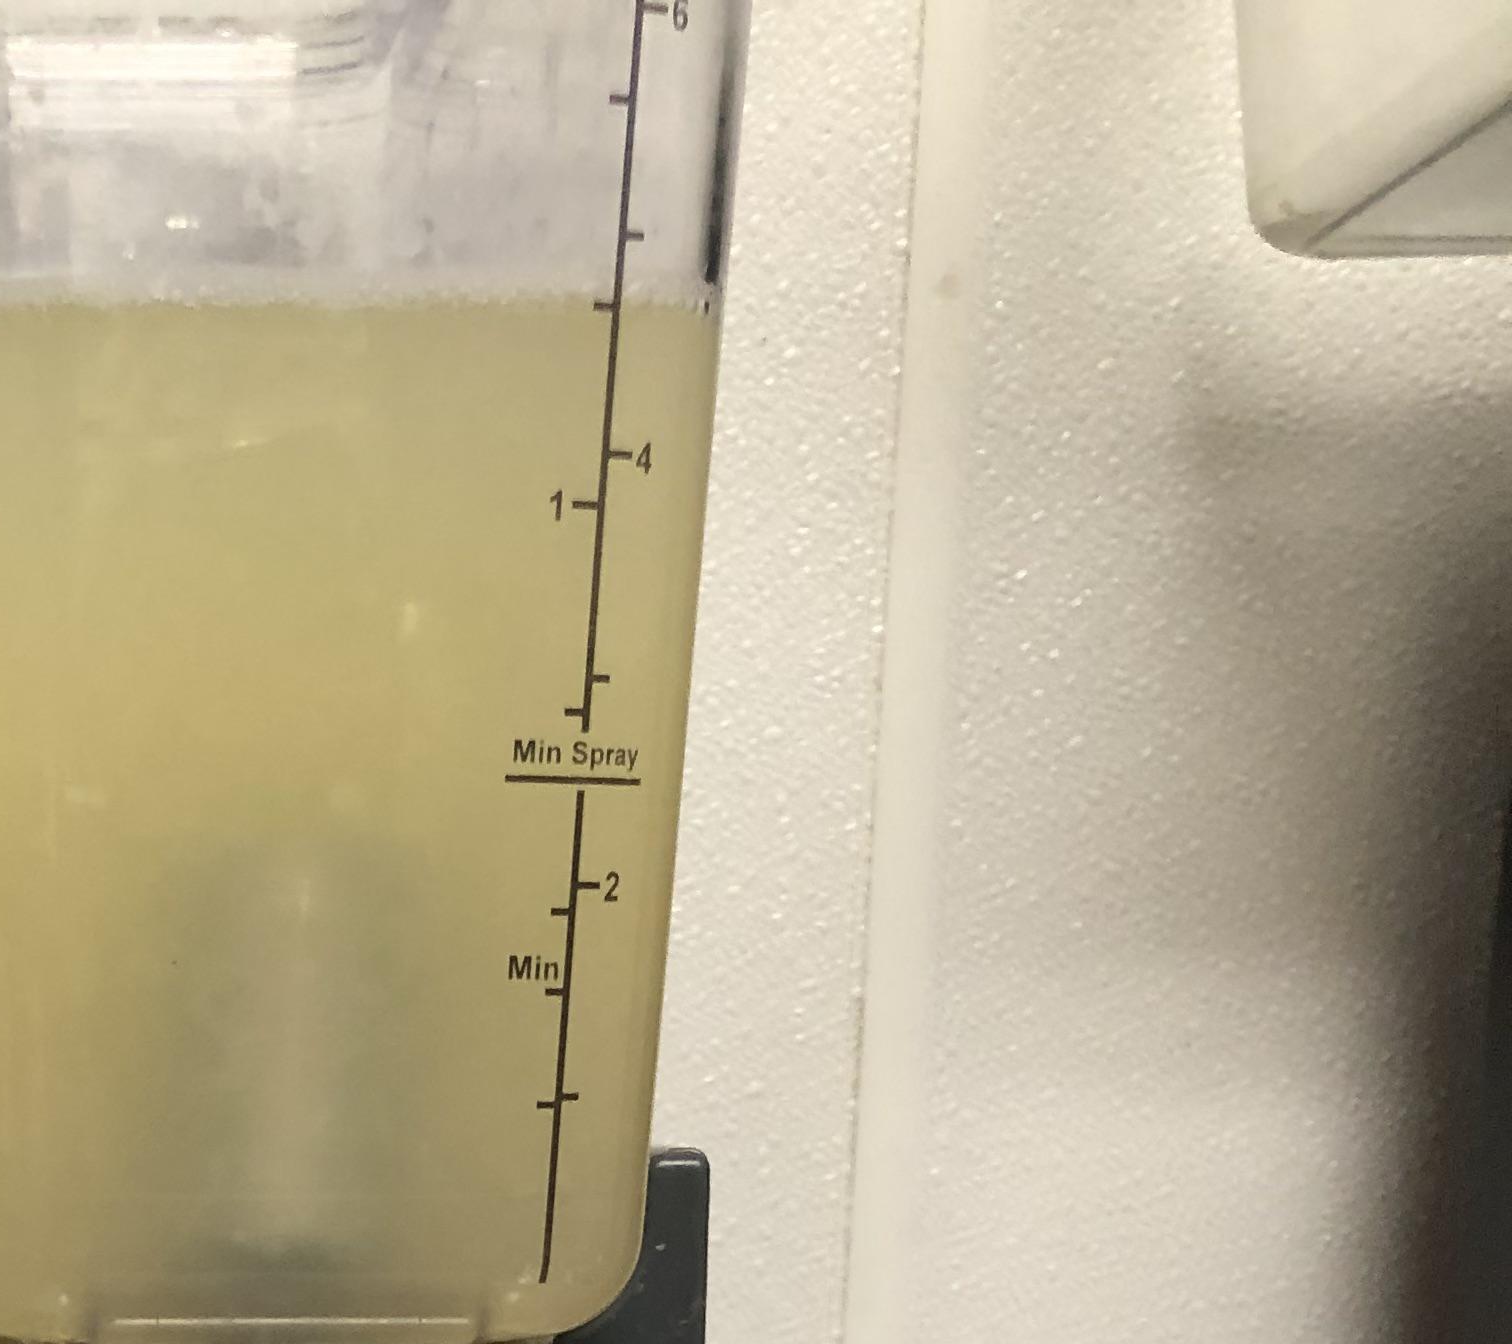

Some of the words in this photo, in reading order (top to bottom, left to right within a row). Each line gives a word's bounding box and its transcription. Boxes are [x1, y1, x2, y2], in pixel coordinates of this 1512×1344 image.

[636, 442, 652, 475] 4
[550, 490, 563, 521] 1
[513, 739, 562, 765] Min
[572, 741, 639, 770] Spray
[604, 871, 620, 902] 2
[508, 955, 559, 981] Min
